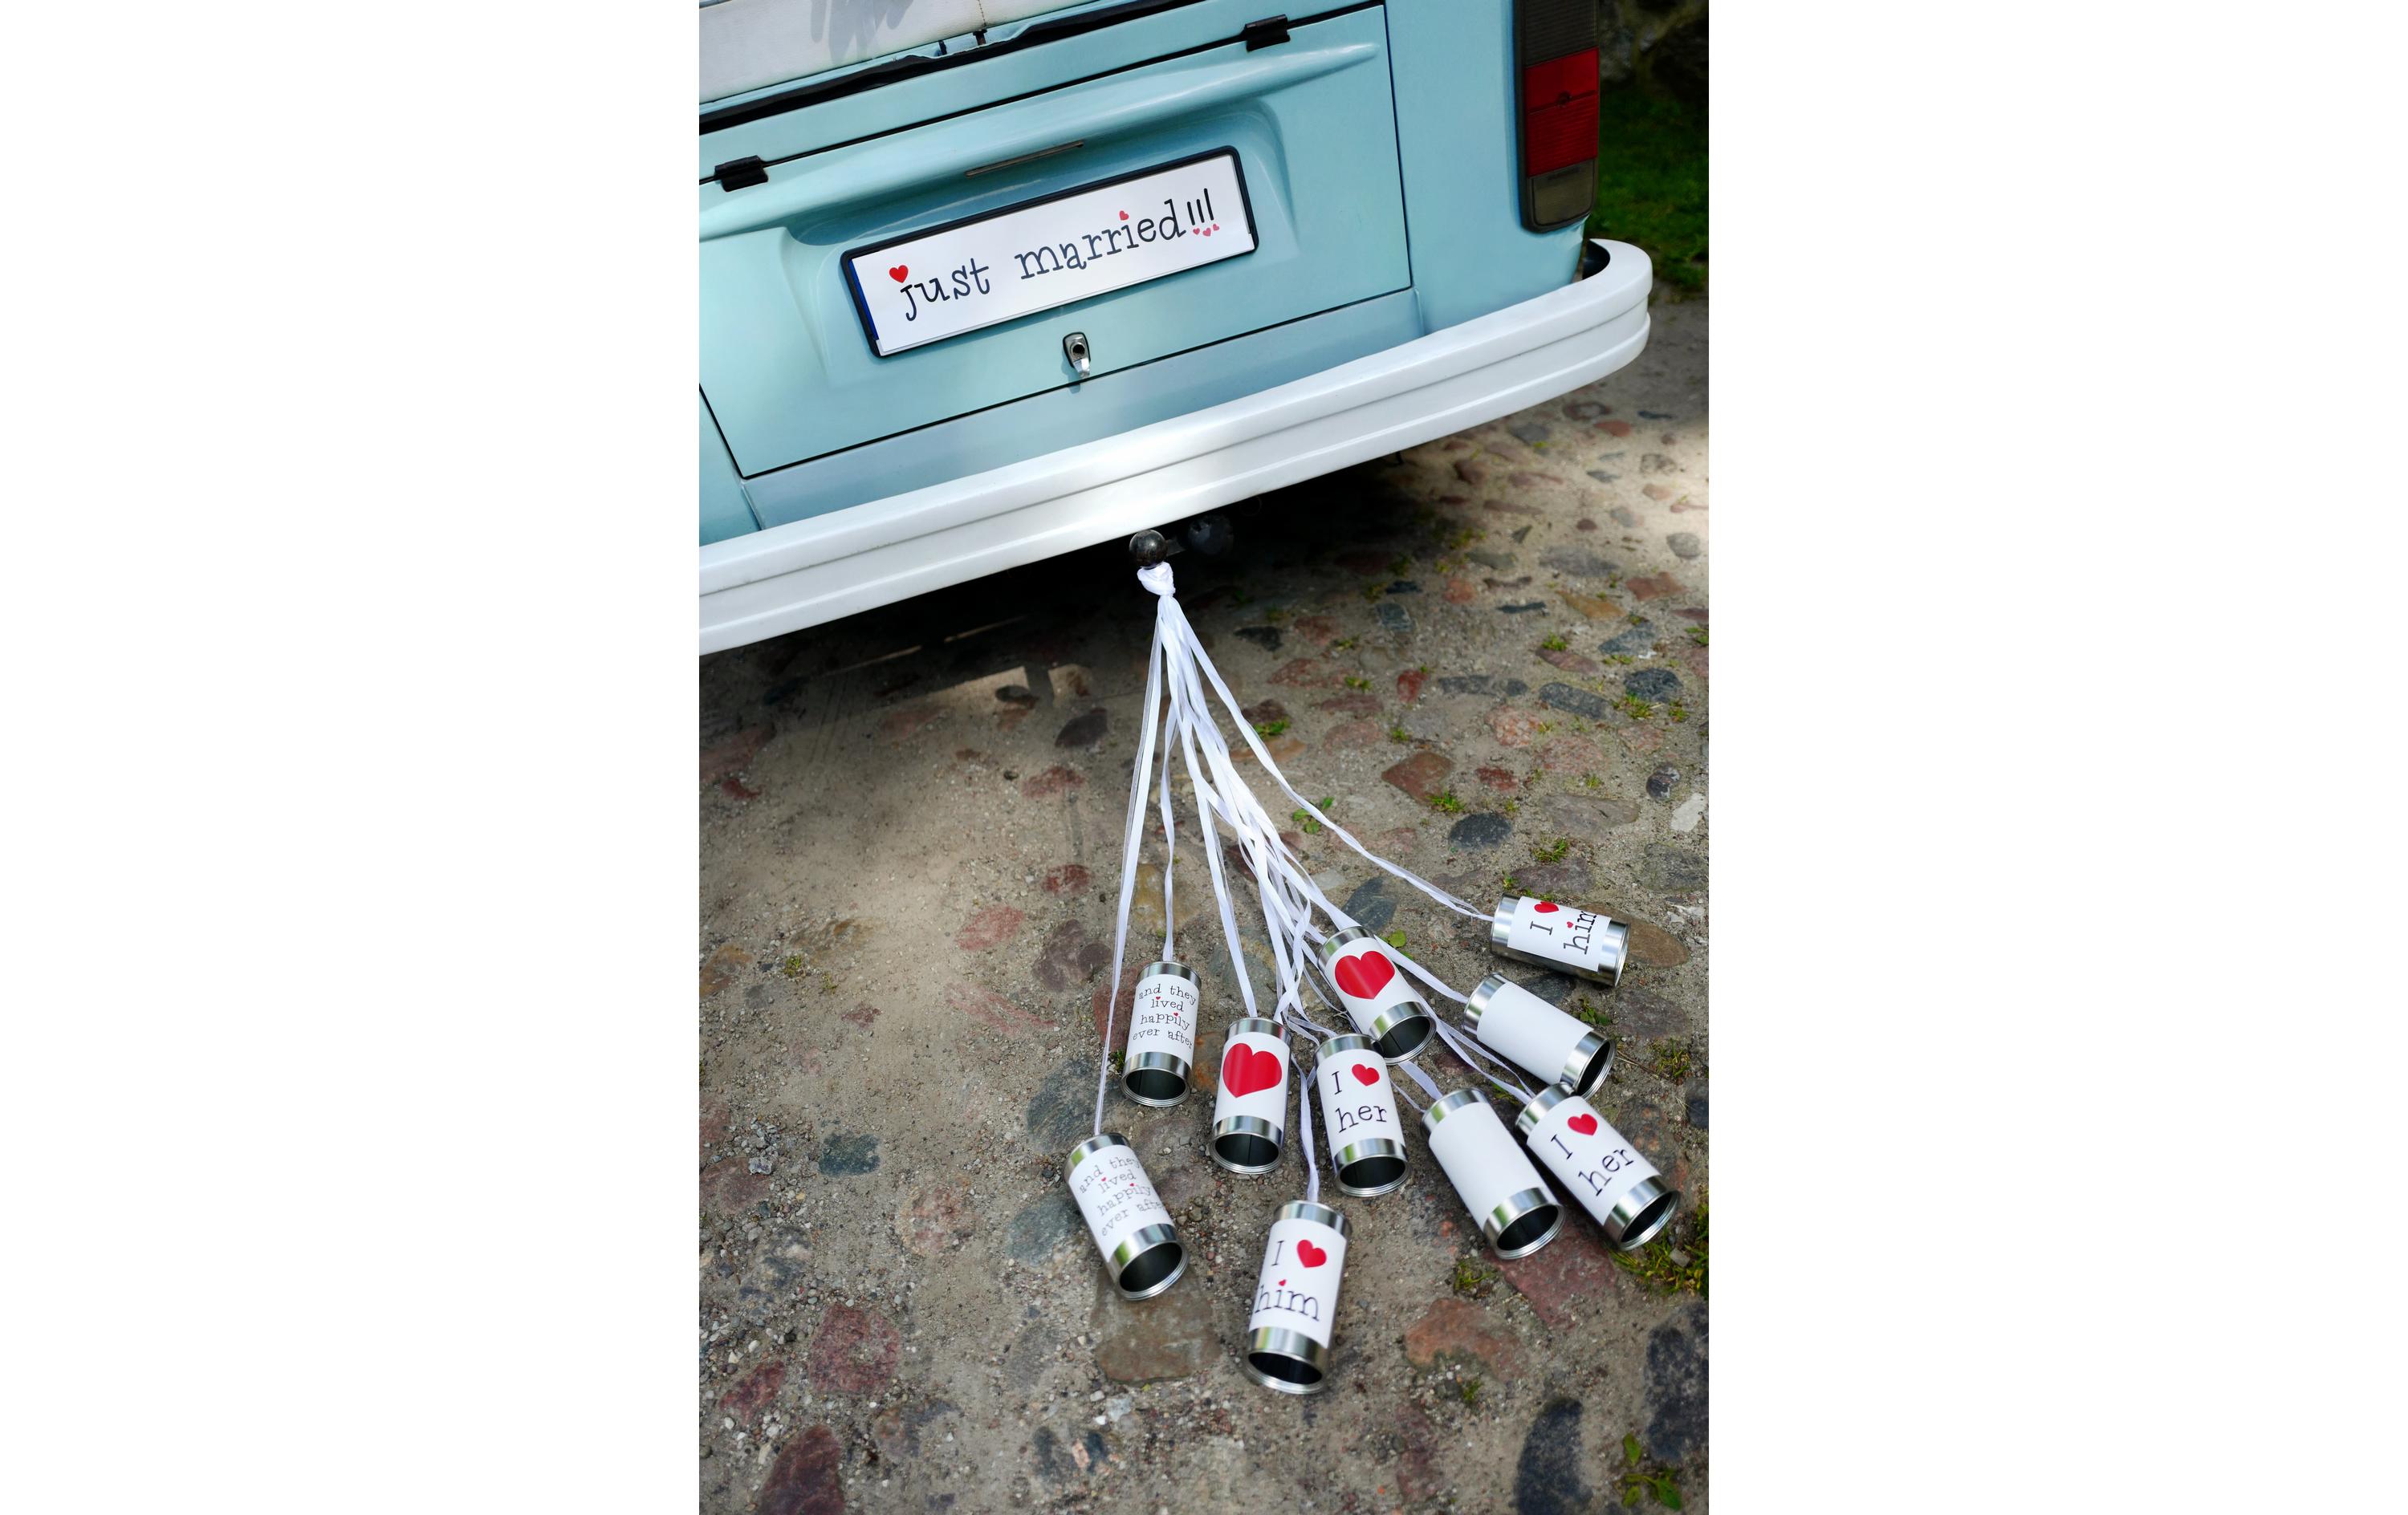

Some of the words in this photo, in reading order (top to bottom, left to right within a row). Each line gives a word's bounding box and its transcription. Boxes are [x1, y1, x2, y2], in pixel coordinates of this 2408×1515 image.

[889, 258, 991, 321] just
[1530, 920, 1553, 936] I
[1138, 984, 1161, 1000] and
[1169, 985, 1196, 1005] they
[1150, 996, 1184, 1013] lived
[1140, 1013, 1190, 1031] happily
[1133, 1028, 1160, 1041] ever
[1168, 1030, 1193, 1050] after
[1332, 1070, 1342, 1095] I
[1335, 1105, 1387, 1133] her
[1550, 1134, 1573, 1160] I
[1080, 1164, 1104, 1194] and
[1098, 1169, 1137, 1194] lived
[1578, 1148, 1634, 1196] her
[1096, 1183, 1151, 1216] happily
[1101, 1209, 1129, 1237] ever
[1271, 1240, 1285, 1267] I
[1255, 1281, 1320, 1322] him
